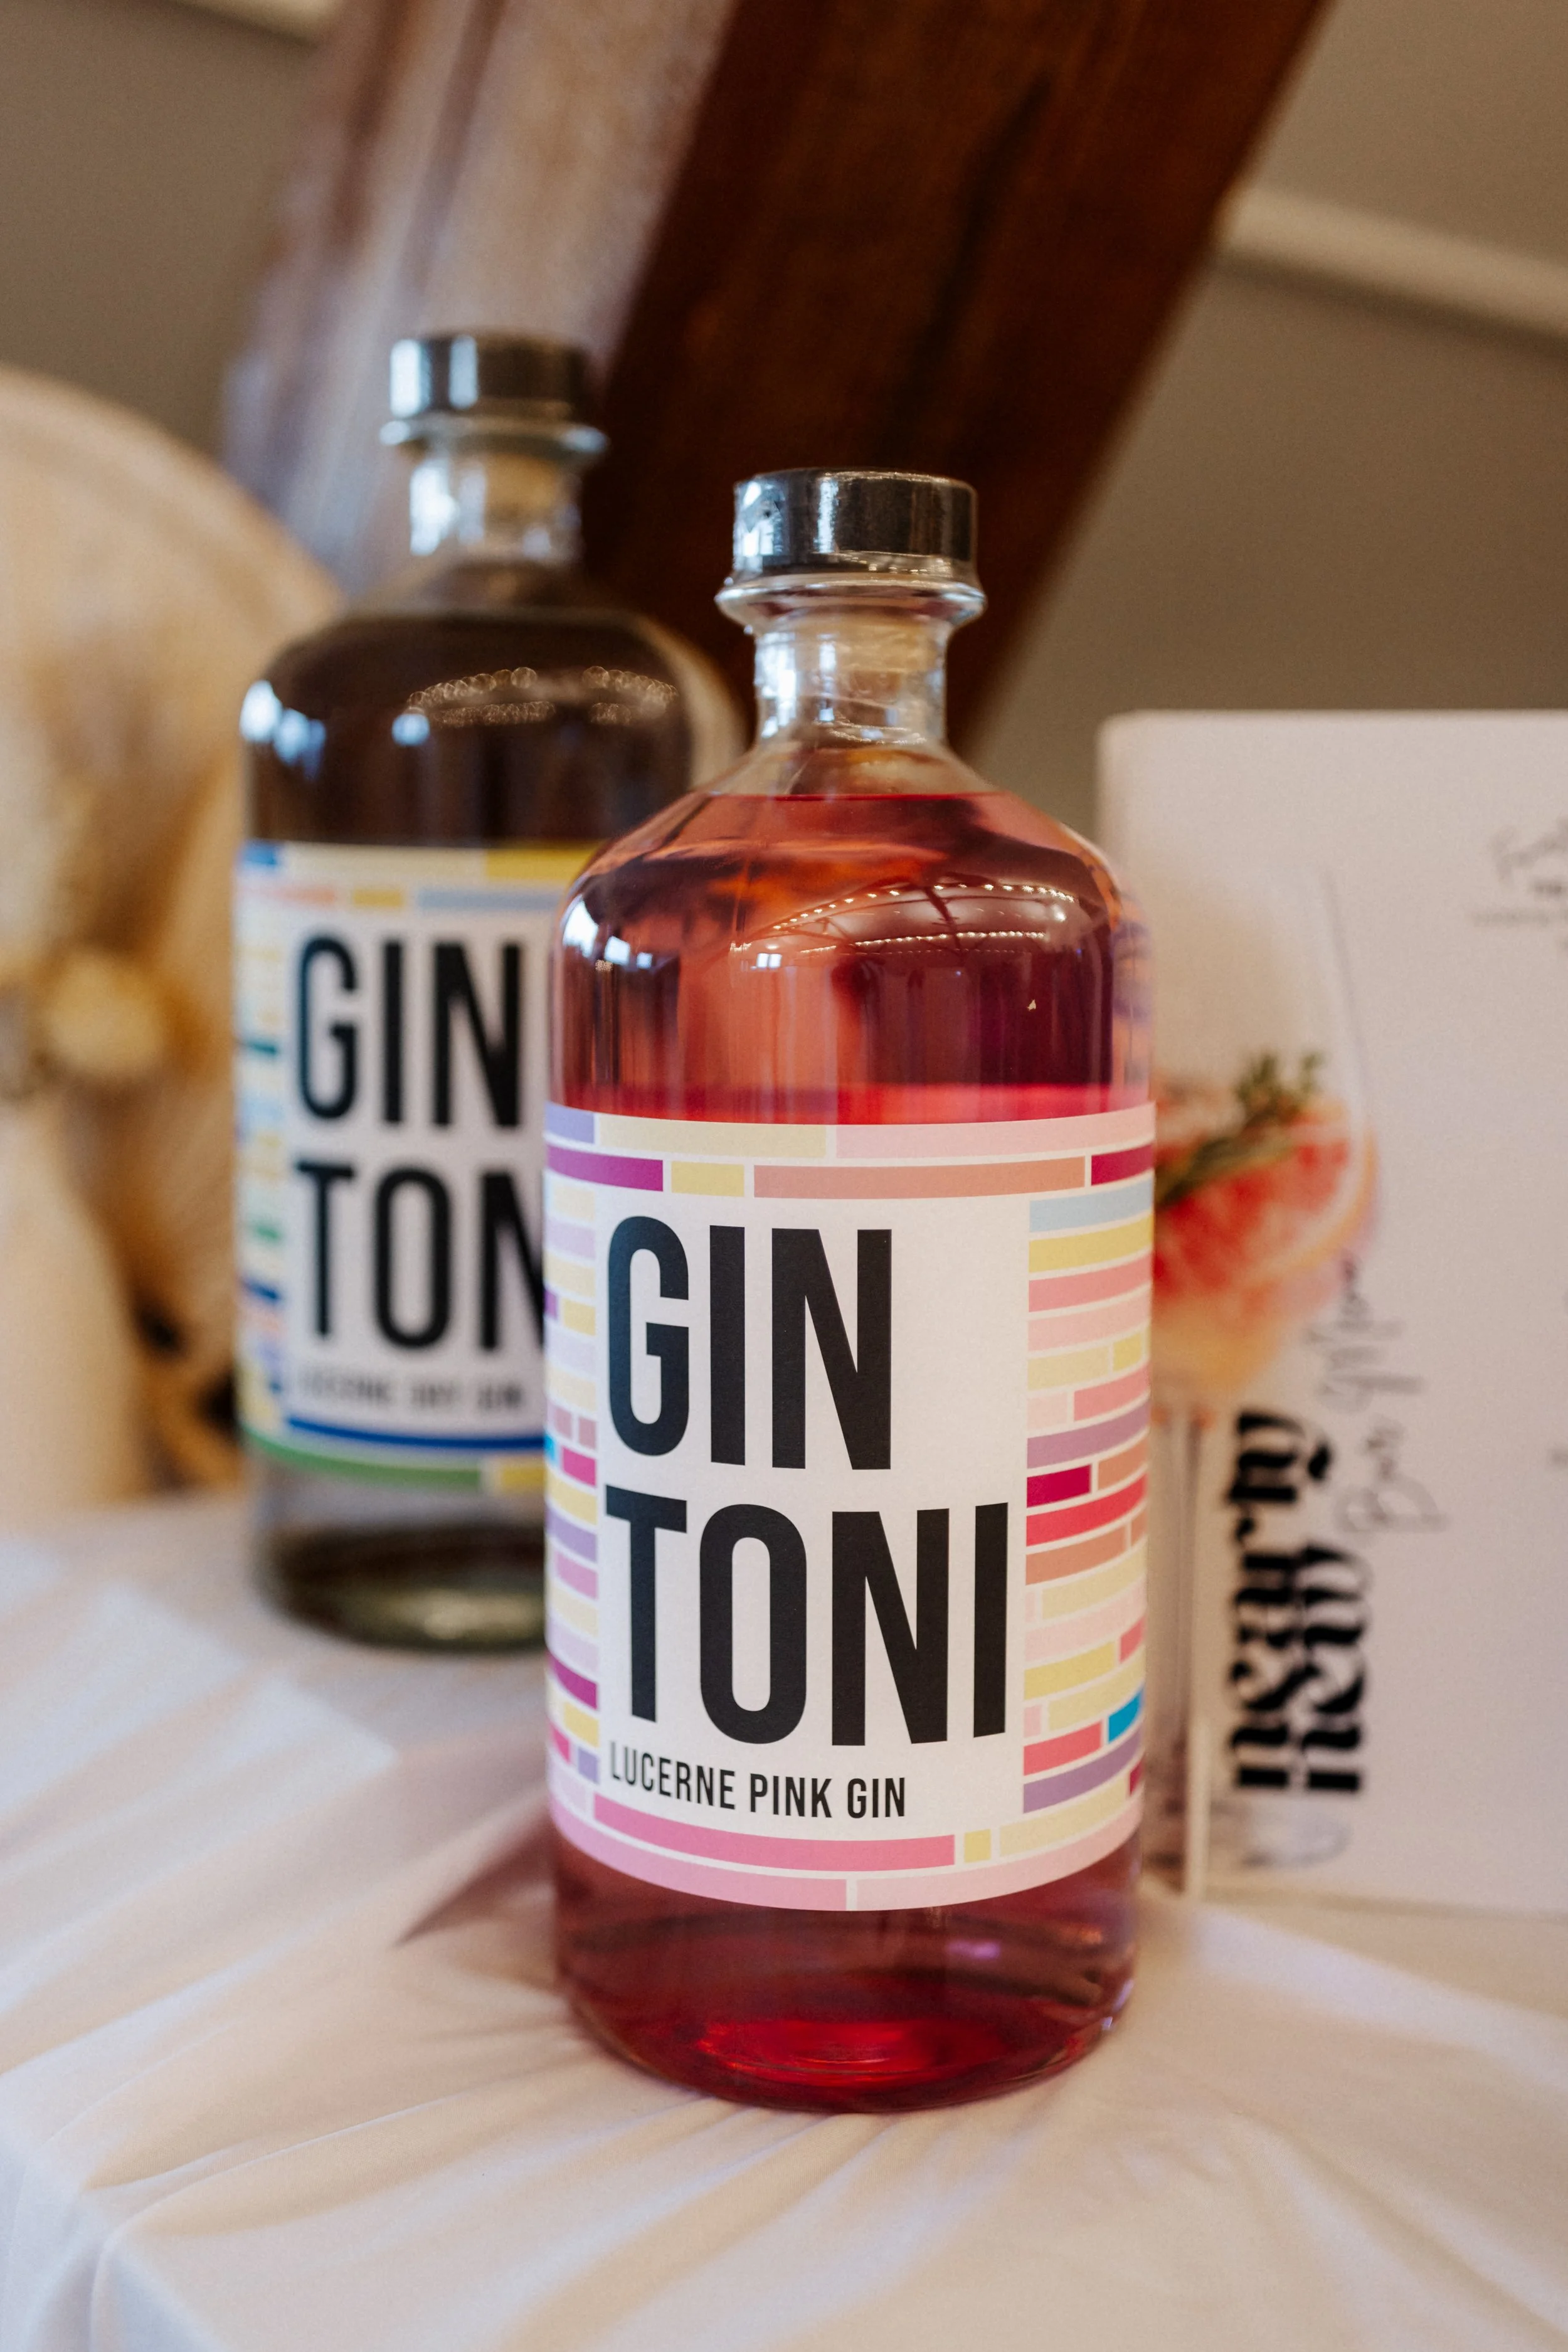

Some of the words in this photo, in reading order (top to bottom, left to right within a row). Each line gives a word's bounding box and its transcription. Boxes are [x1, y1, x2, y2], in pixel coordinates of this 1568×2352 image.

[297, 934, 526, 1130] GIN
[607, 1215, 893, 1471] GIN
[605, 1484, 1009, 1746] TONI
[610, 1740, 736, 1810] LUCERNE
[750, 1772, 832, 1818] PINK
[847, 1777, 906, 1819] GIN
